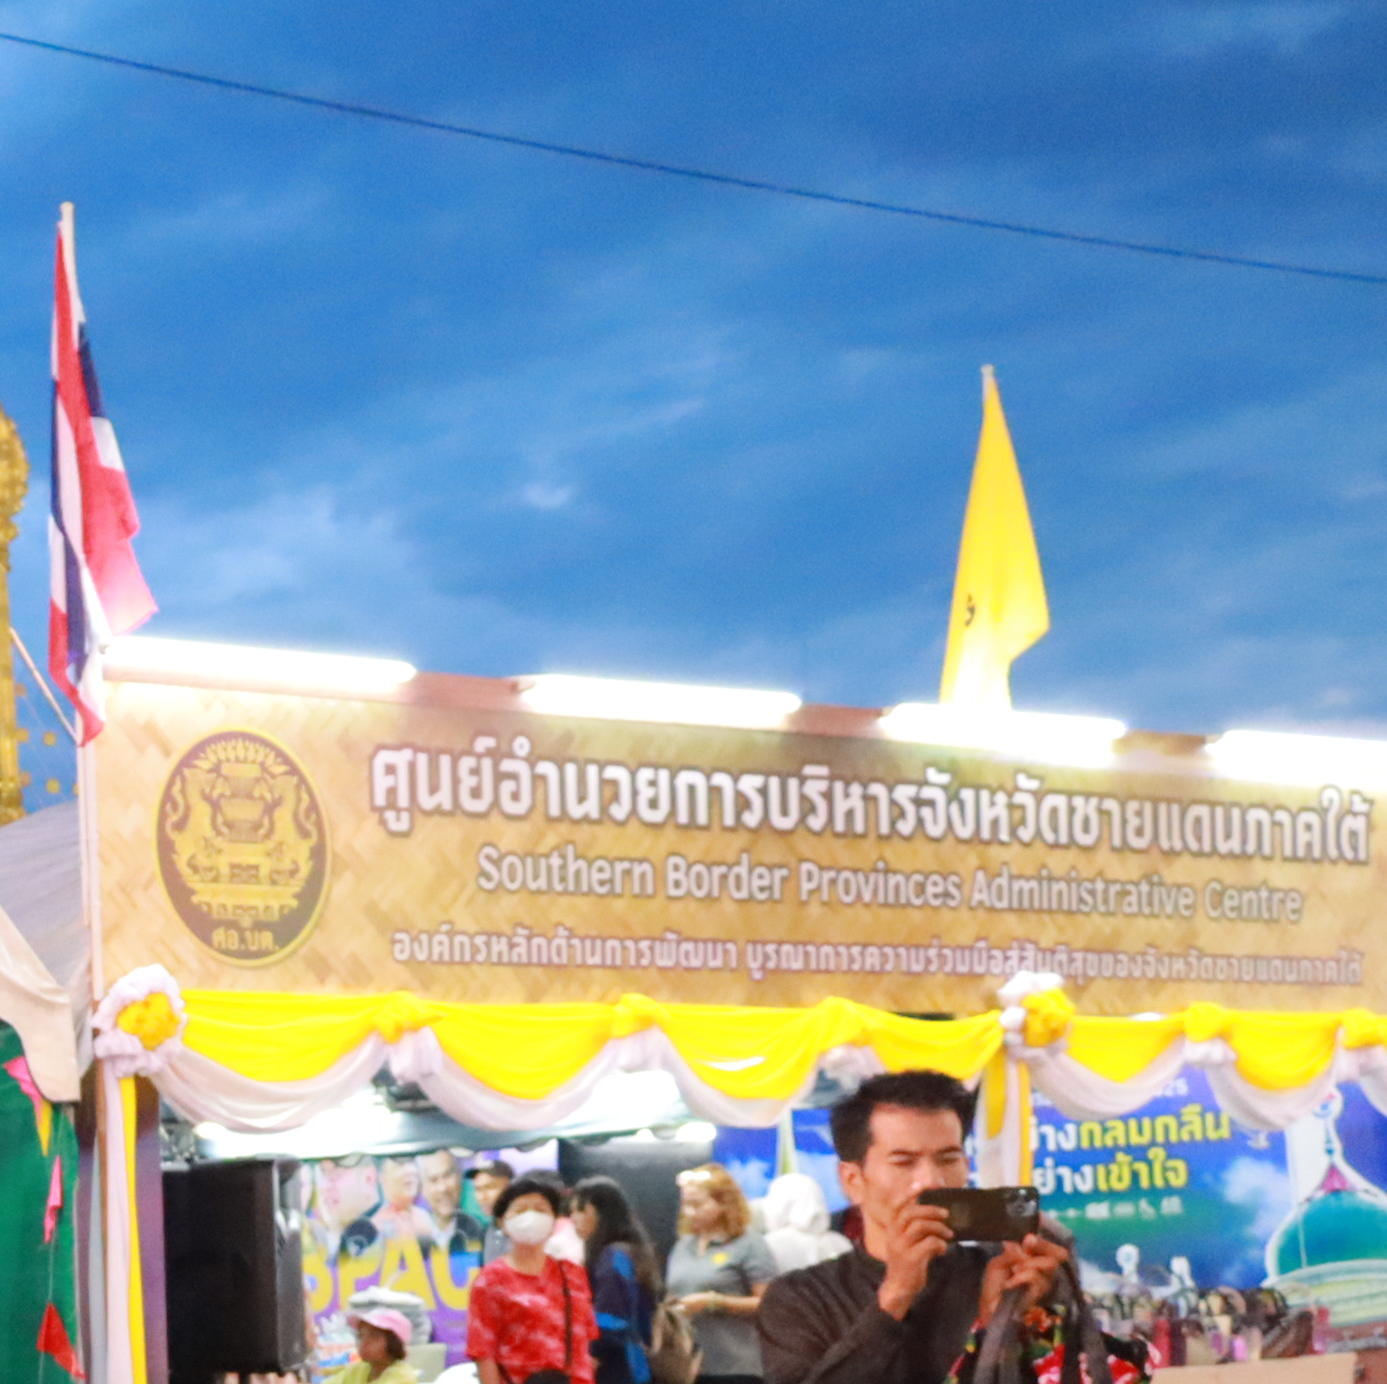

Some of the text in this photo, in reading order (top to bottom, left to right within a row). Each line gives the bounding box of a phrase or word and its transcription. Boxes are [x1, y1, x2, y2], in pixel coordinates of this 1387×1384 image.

[370, 735, 1374, 863] ศูนย์อำนวยการบริหารจังหวัดชายแดนภาคใต้
[477, 845, 1304, 923] Southern Border Provinces Administrative Centre
